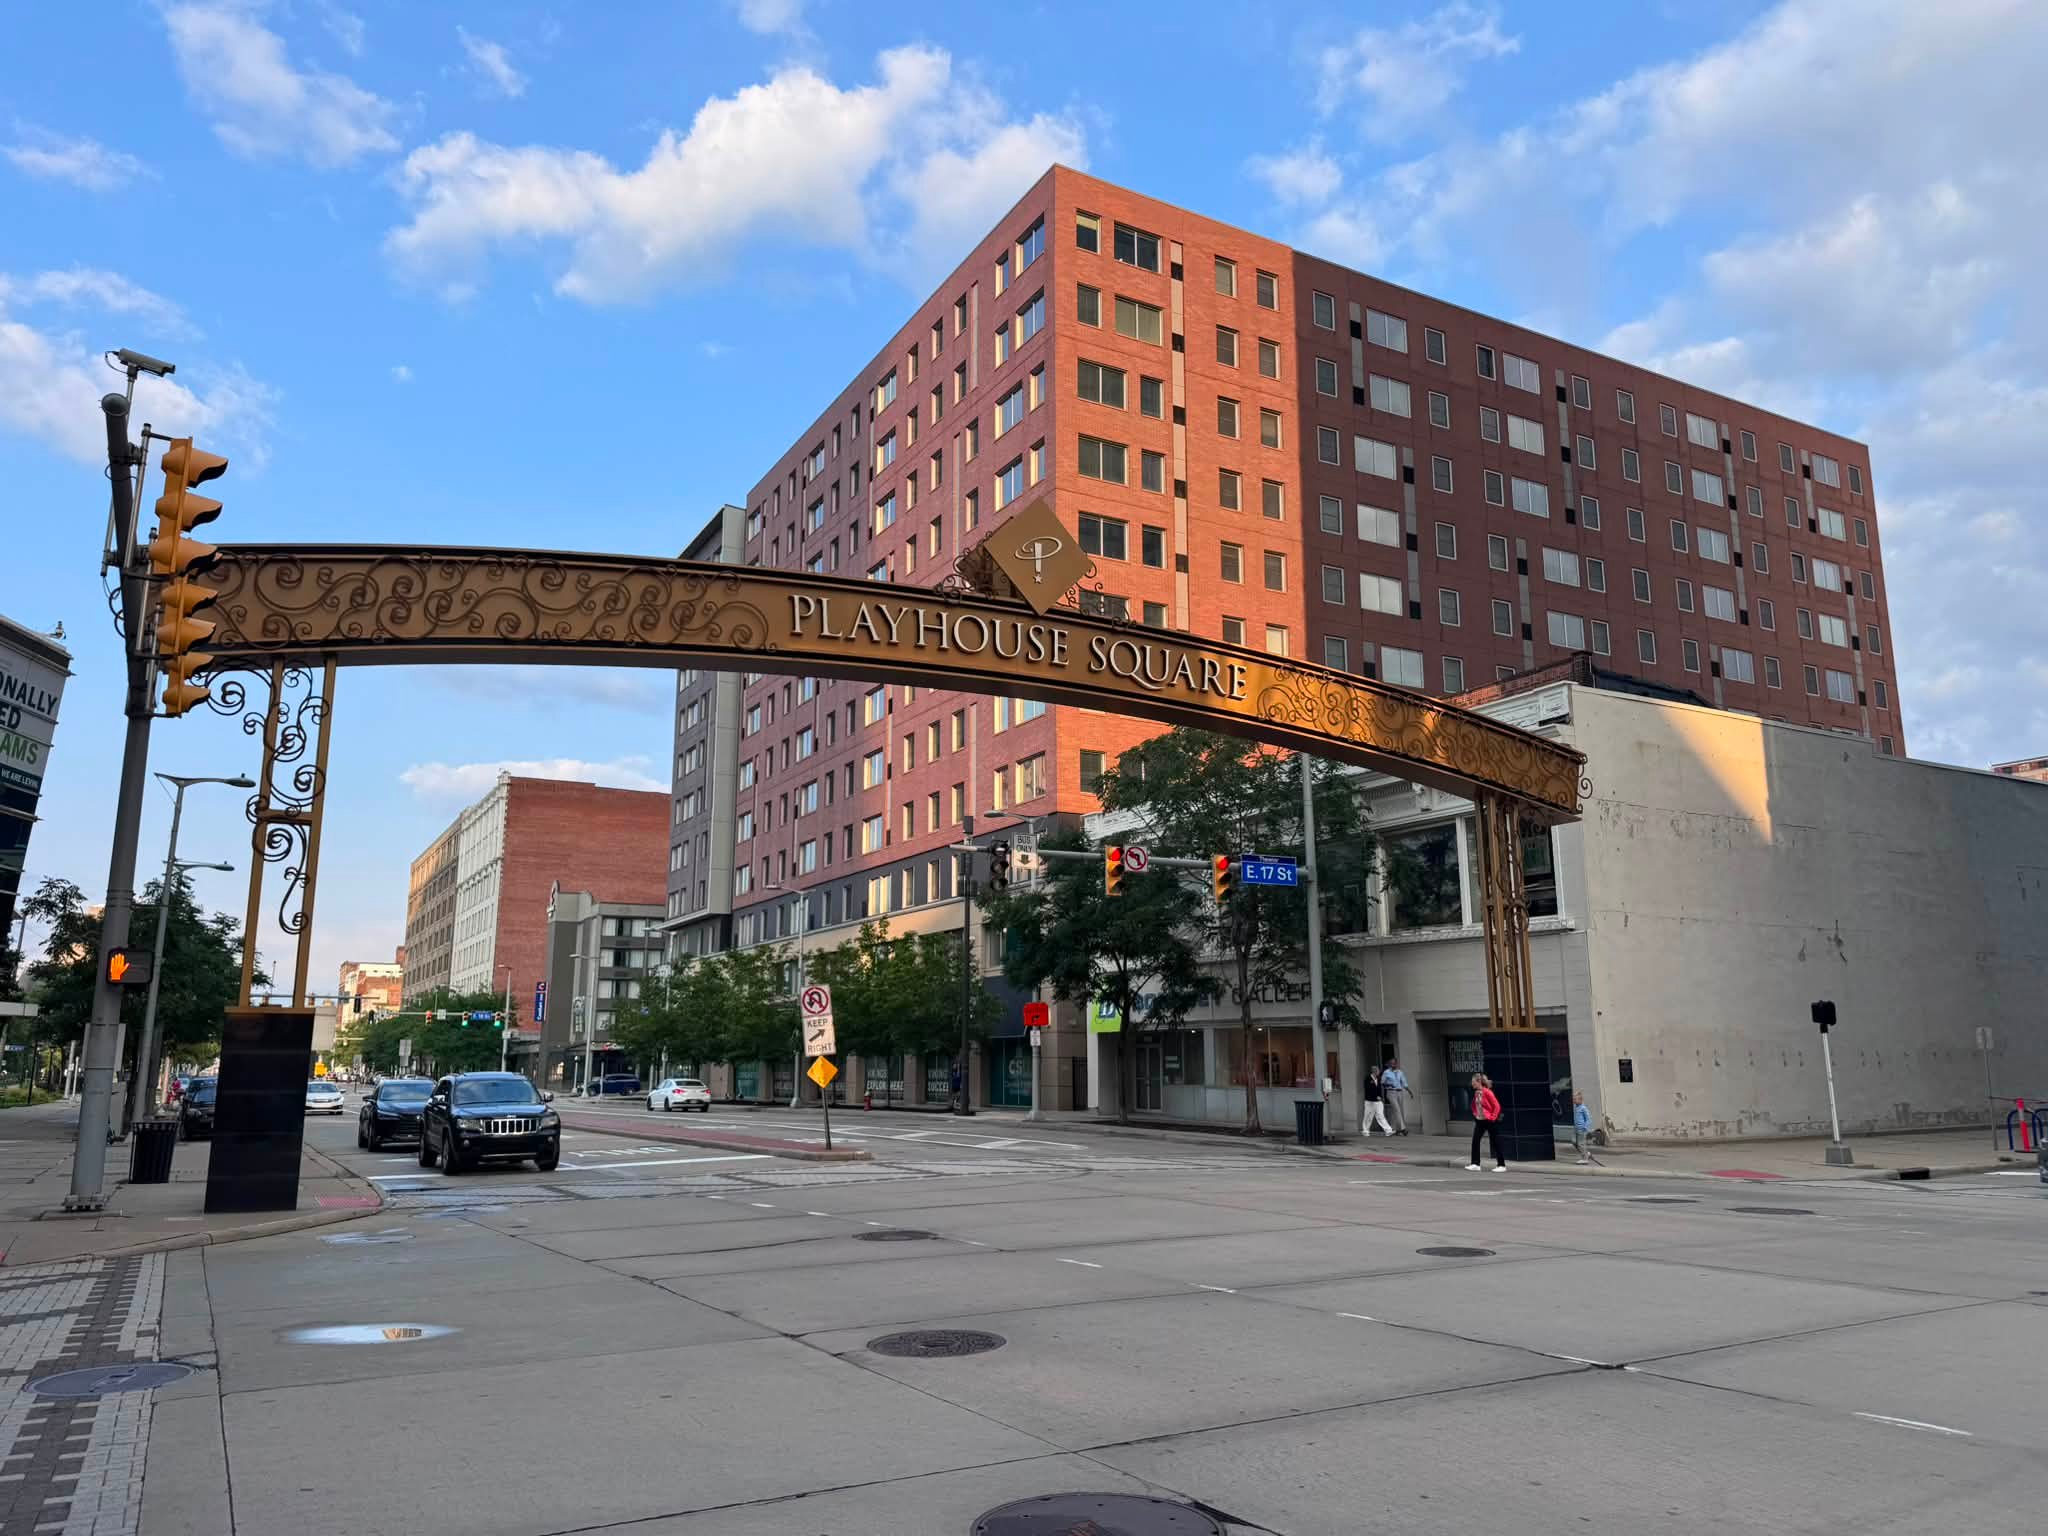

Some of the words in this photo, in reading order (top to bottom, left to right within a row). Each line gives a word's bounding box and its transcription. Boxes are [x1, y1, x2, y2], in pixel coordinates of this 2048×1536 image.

[790, 594, 1070, 666] PLAYHOUSE
[1090, 636, 1248, 700] SQUARE
[1017, 835, 1032, 844] BUS
[1246, 864, 1258, 879] E.
[1260, 865, 1274, 880] 17
[1277, 866, 1292, 881] St
[1232, 982, 1312, 1006] GALLER
[807, 1018, 828, 1028] KEEP
[807, 1042, 832, 1054] RIGHT
